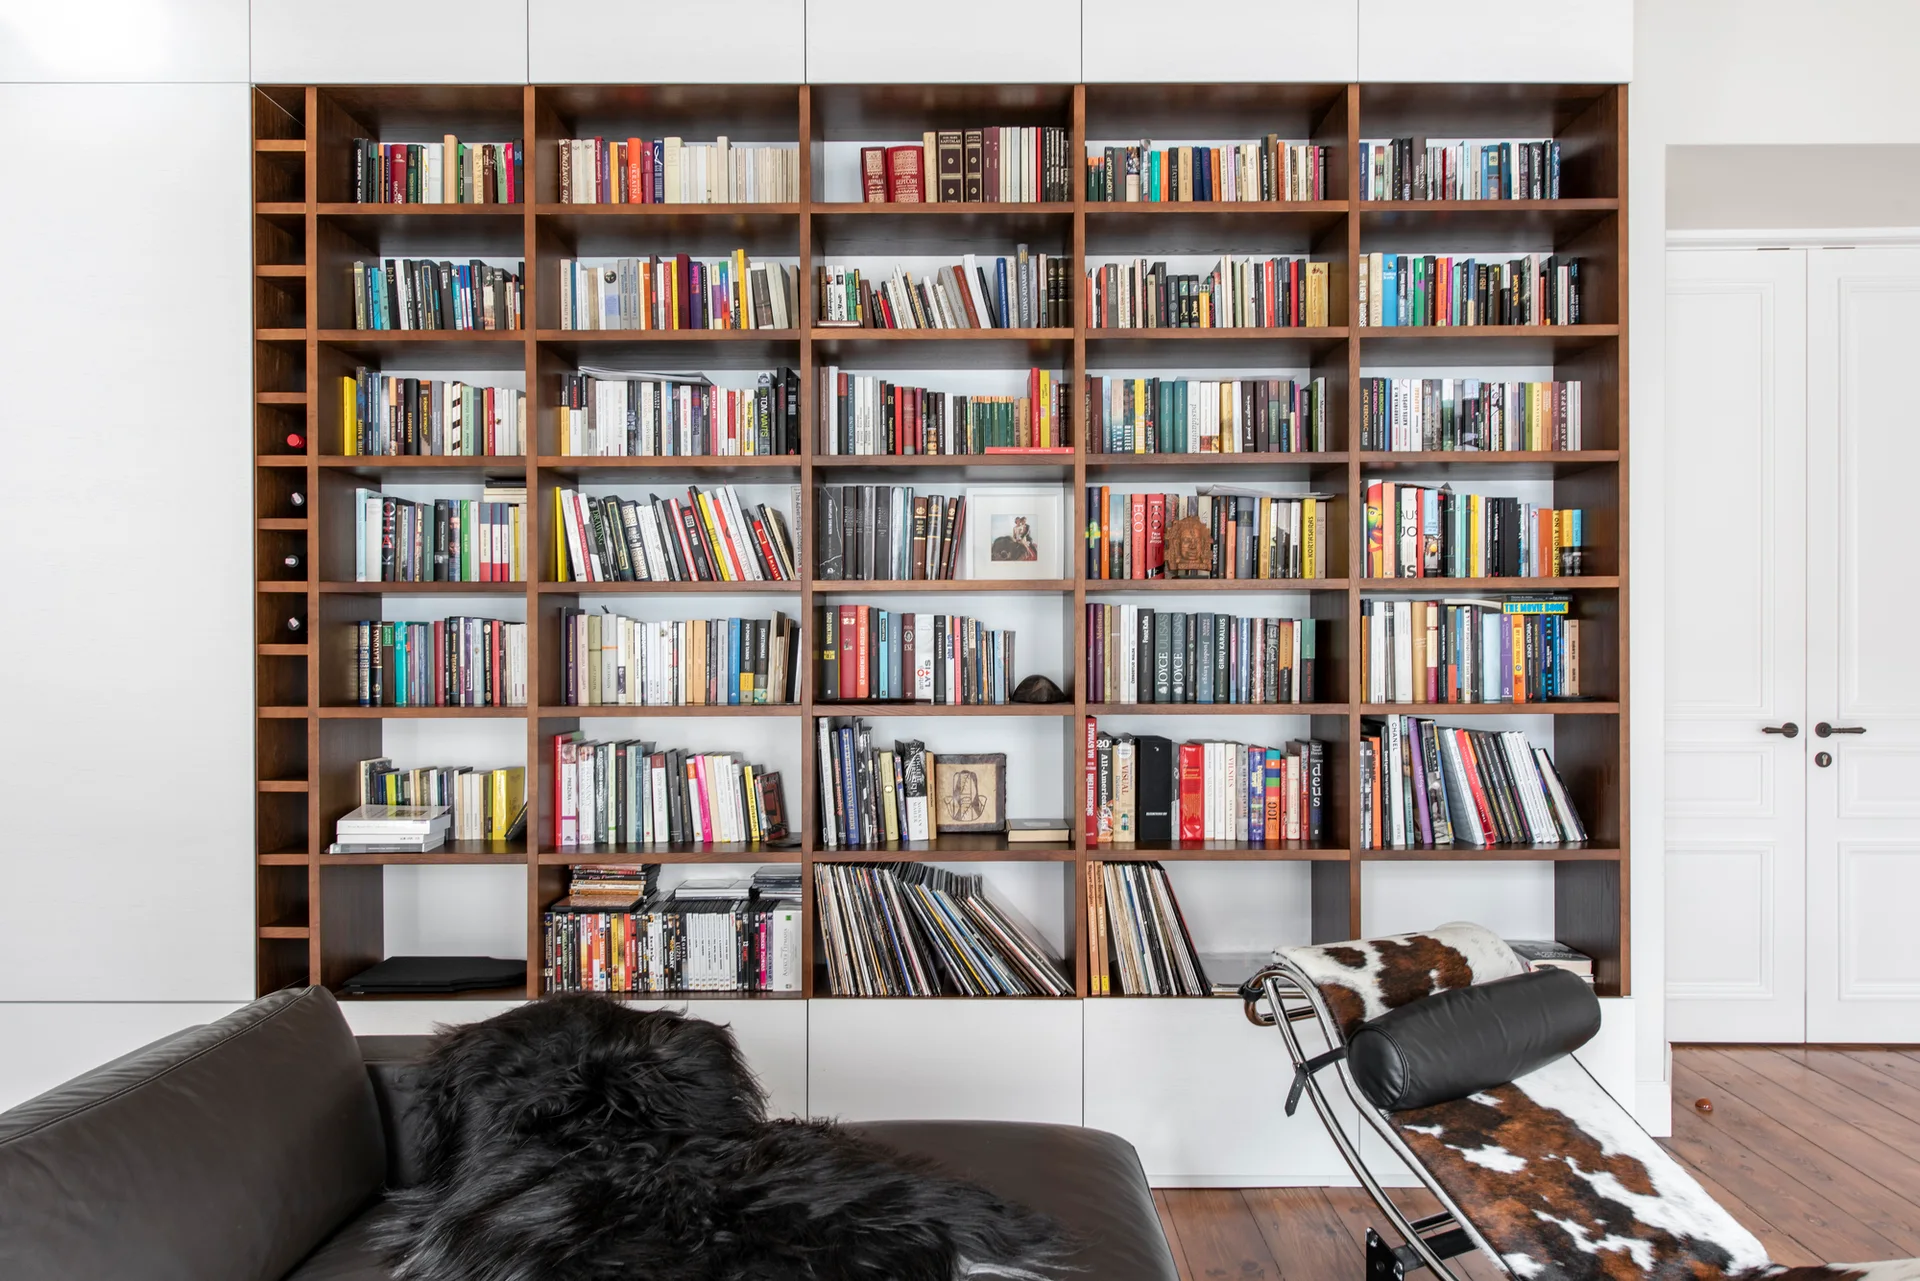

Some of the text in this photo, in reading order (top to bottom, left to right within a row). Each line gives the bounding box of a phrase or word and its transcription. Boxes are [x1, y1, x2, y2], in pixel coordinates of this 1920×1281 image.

[692, 406, 701, 435] Unamuno
[592, 508, 604, 546] DRAWING
[1134, 504, 1143, 532] ECO
[1151, 505, 1162, 530] ECO
[1504, 603, 1566, 612] THE MOVIE BOOK
[1158, 614, 1169, 687] JOYCE ULISAS
[1173, 614, 1183, 687] JOYCE ULISAS
[1201, 665, 1209, 684] knyga
[1088, 750, 1094, 759] НА
[1101, 754, 1109, 810] All-American
[1121, 765, 1129, 796] VISUAL
